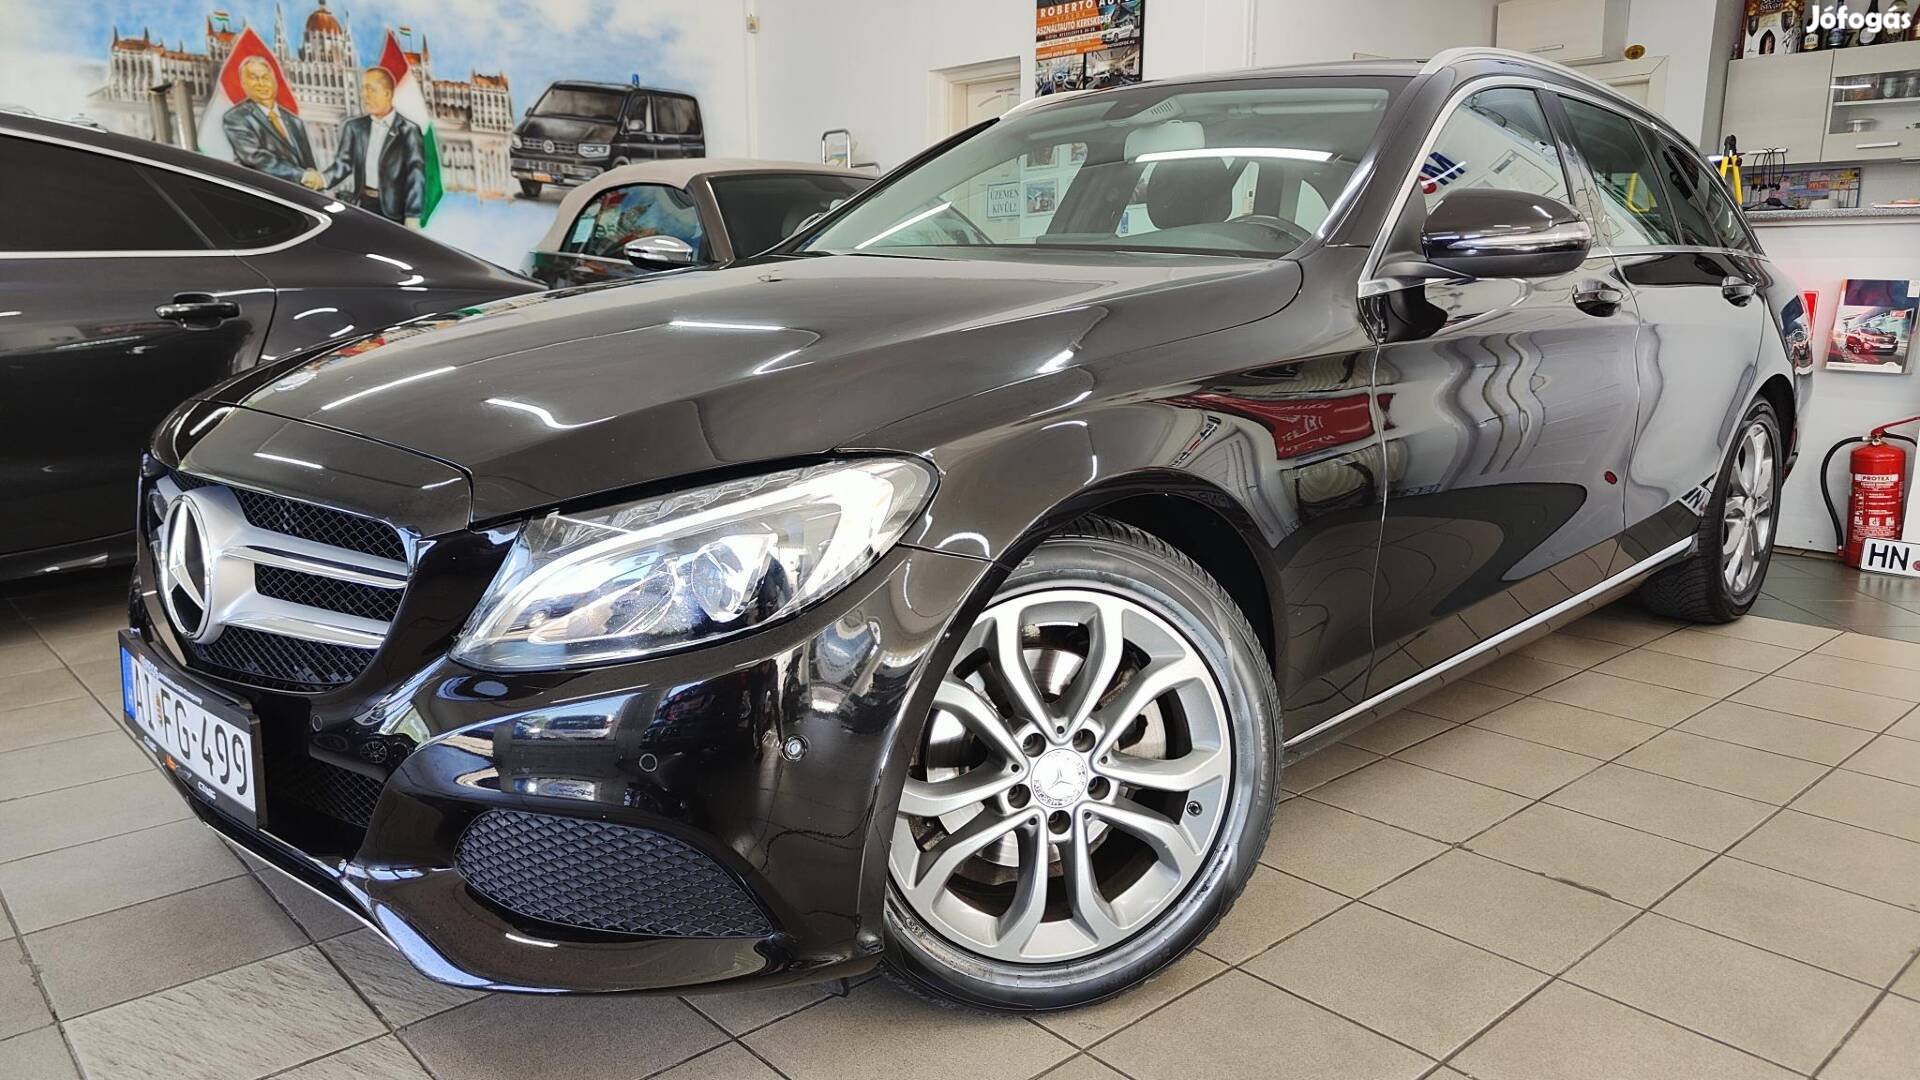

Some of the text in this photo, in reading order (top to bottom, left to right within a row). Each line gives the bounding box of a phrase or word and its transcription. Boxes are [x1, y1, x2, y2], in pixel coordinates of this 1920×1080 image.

[1040, 0, 1093, 18] ROBERTO
[1868, 543, 1910, 570] HN
[161, 687, 248, 796] FG-499
